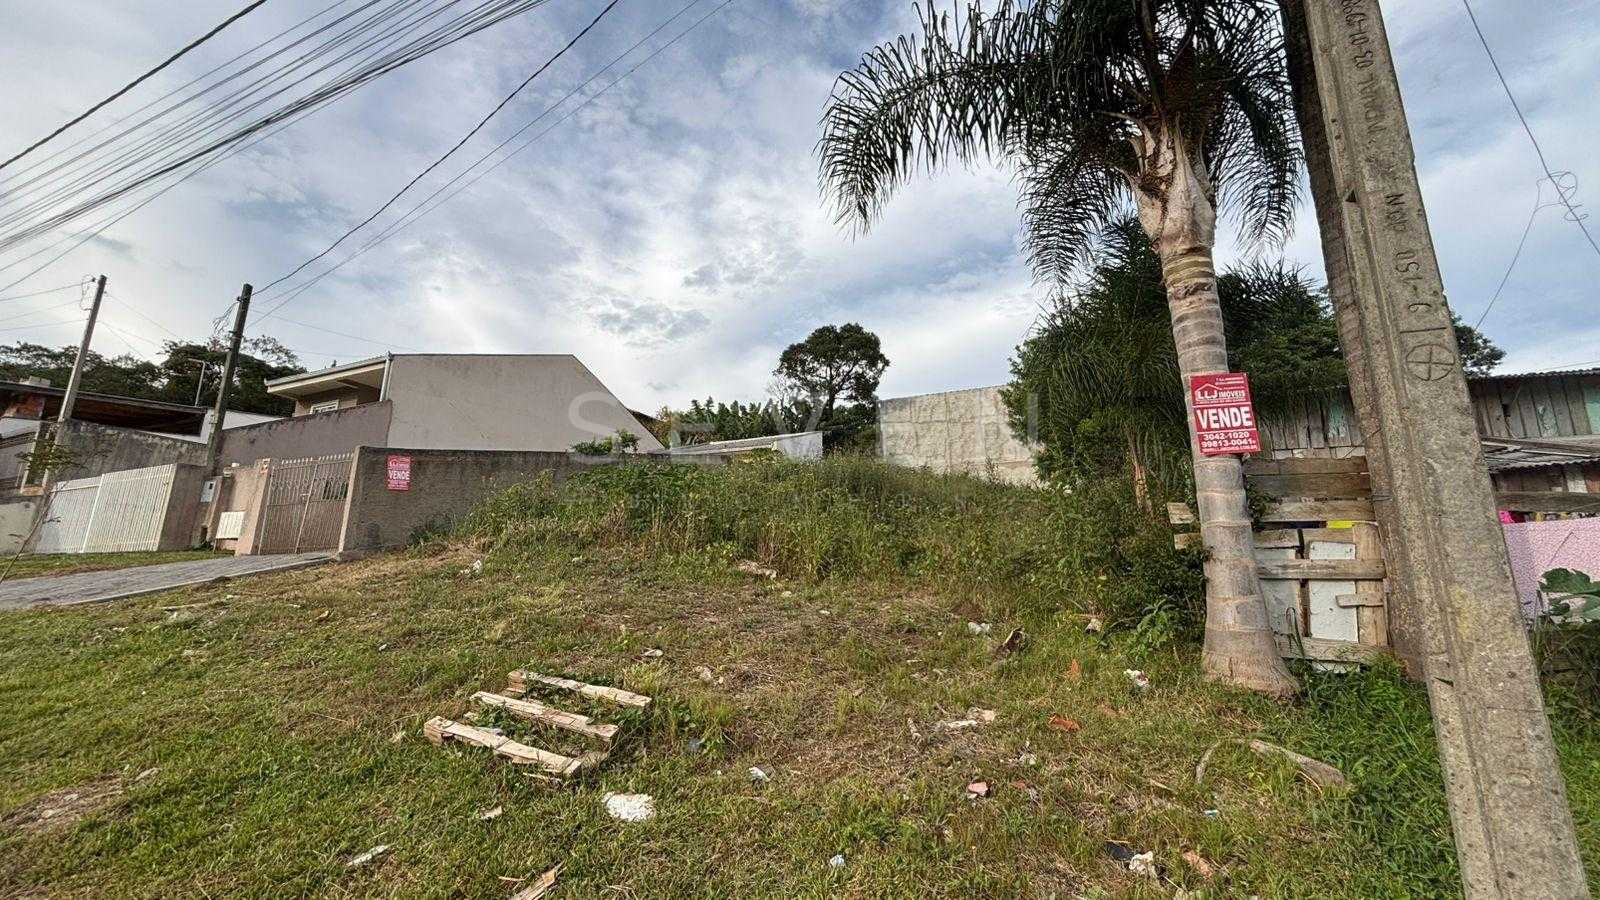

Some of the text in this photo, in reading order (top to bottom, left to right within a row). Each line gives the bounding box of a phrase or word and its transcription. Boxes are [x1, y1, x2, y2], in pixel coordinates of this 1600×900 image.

[1197, 407, 1253, 429] VENDE
[1203, 431, 1250, 441] 3042-1020
[1201, 438, 1253, 448] 99813-0041
[388, 470, 410, 480] VENDE
